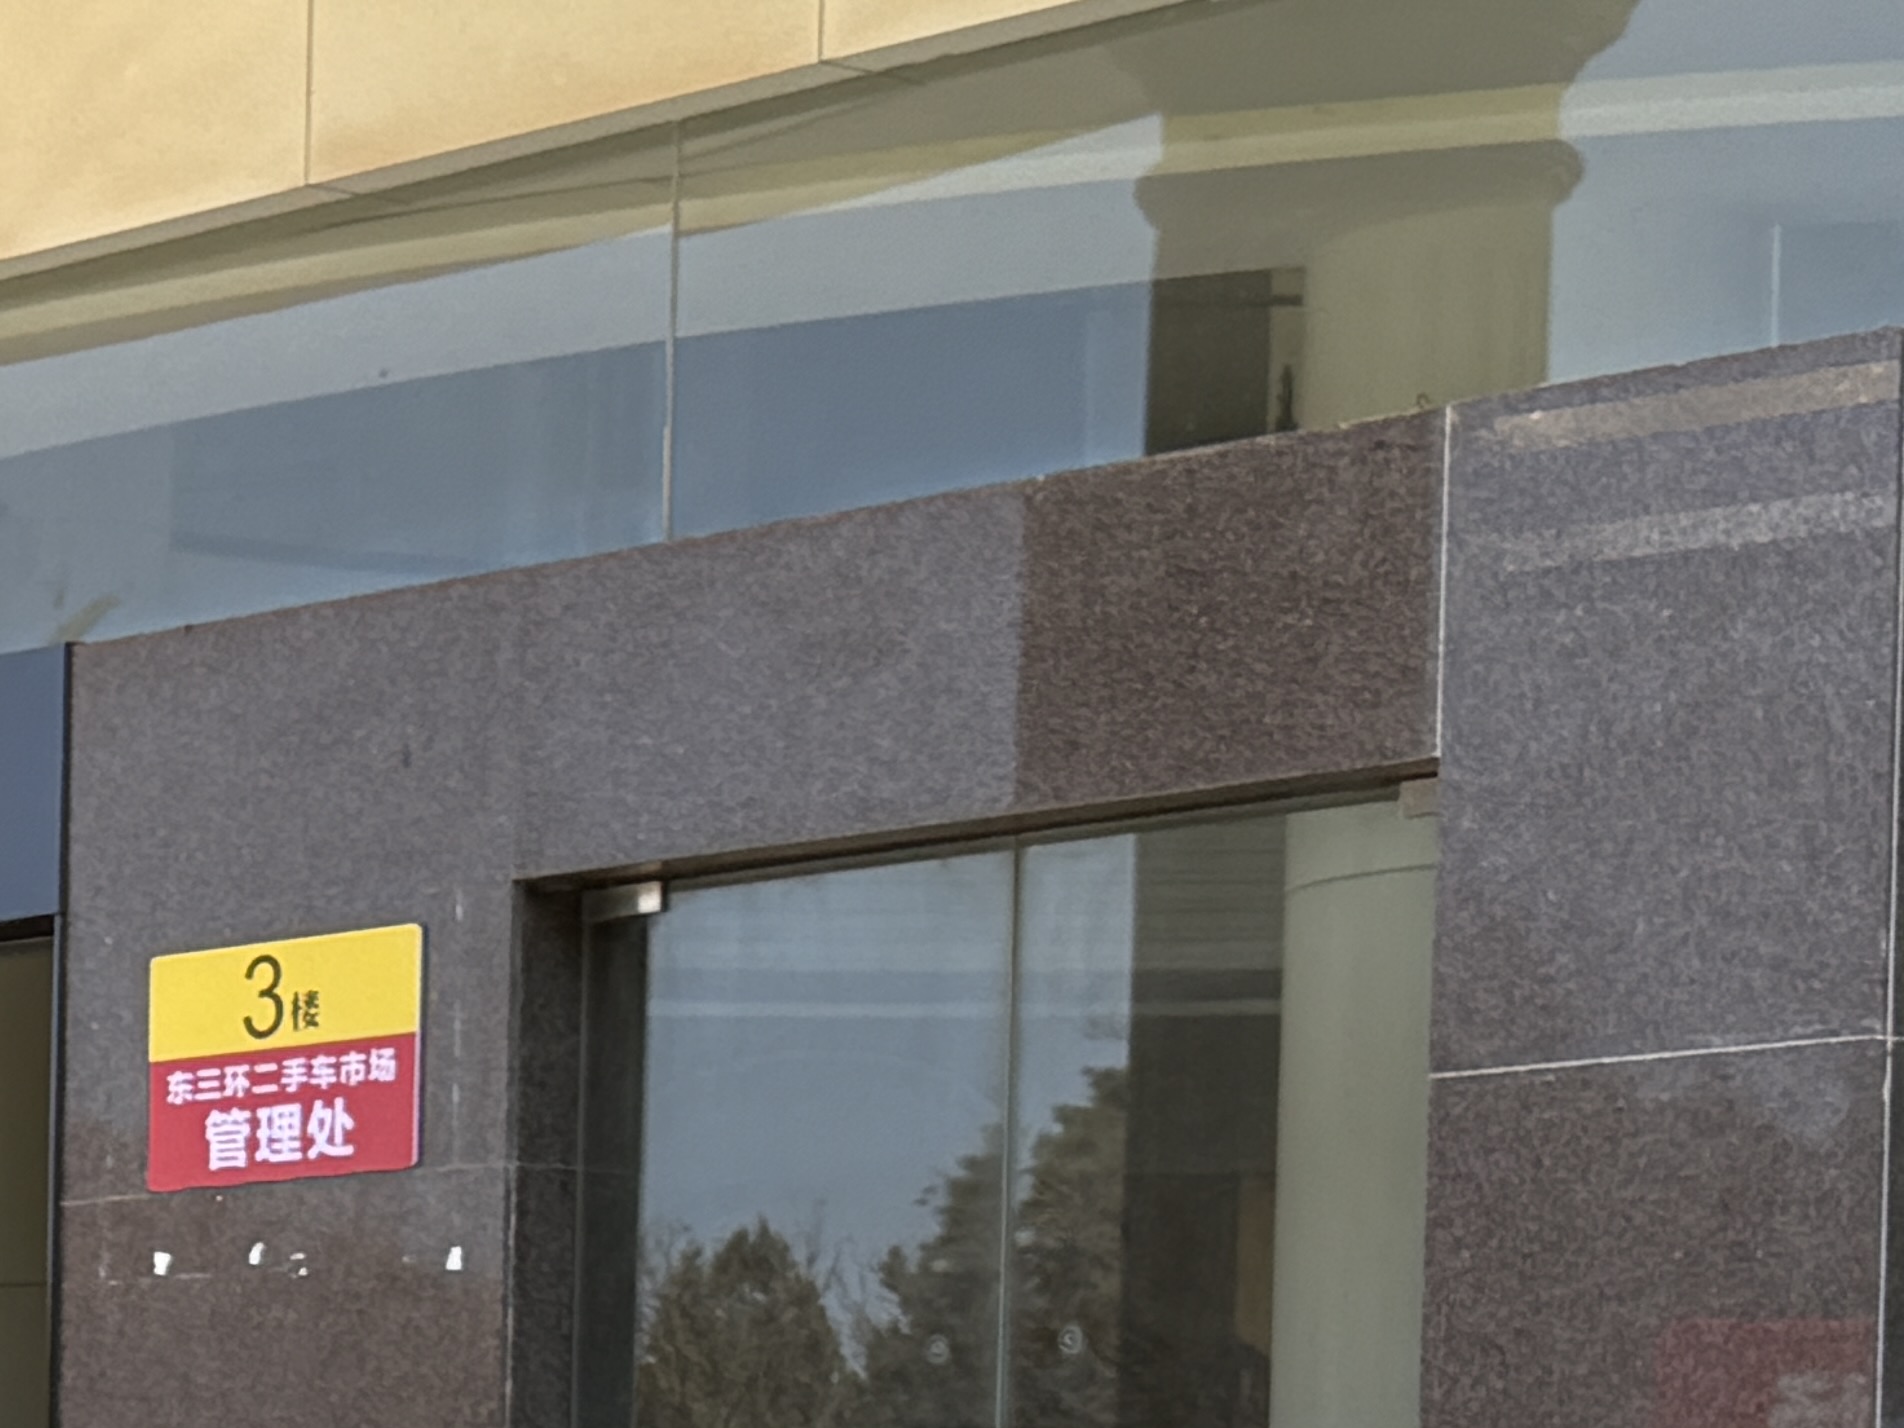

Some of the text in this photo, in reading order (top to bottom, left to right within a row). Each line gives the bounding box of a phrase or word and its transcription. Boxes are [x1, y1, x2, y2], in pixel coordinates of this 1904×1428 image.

[243, 954, 320, 1040] 3楼
[166, 1047, 397, 1105] 东三环二手车市场
[204, 1097, 355, 1171] 管理处
